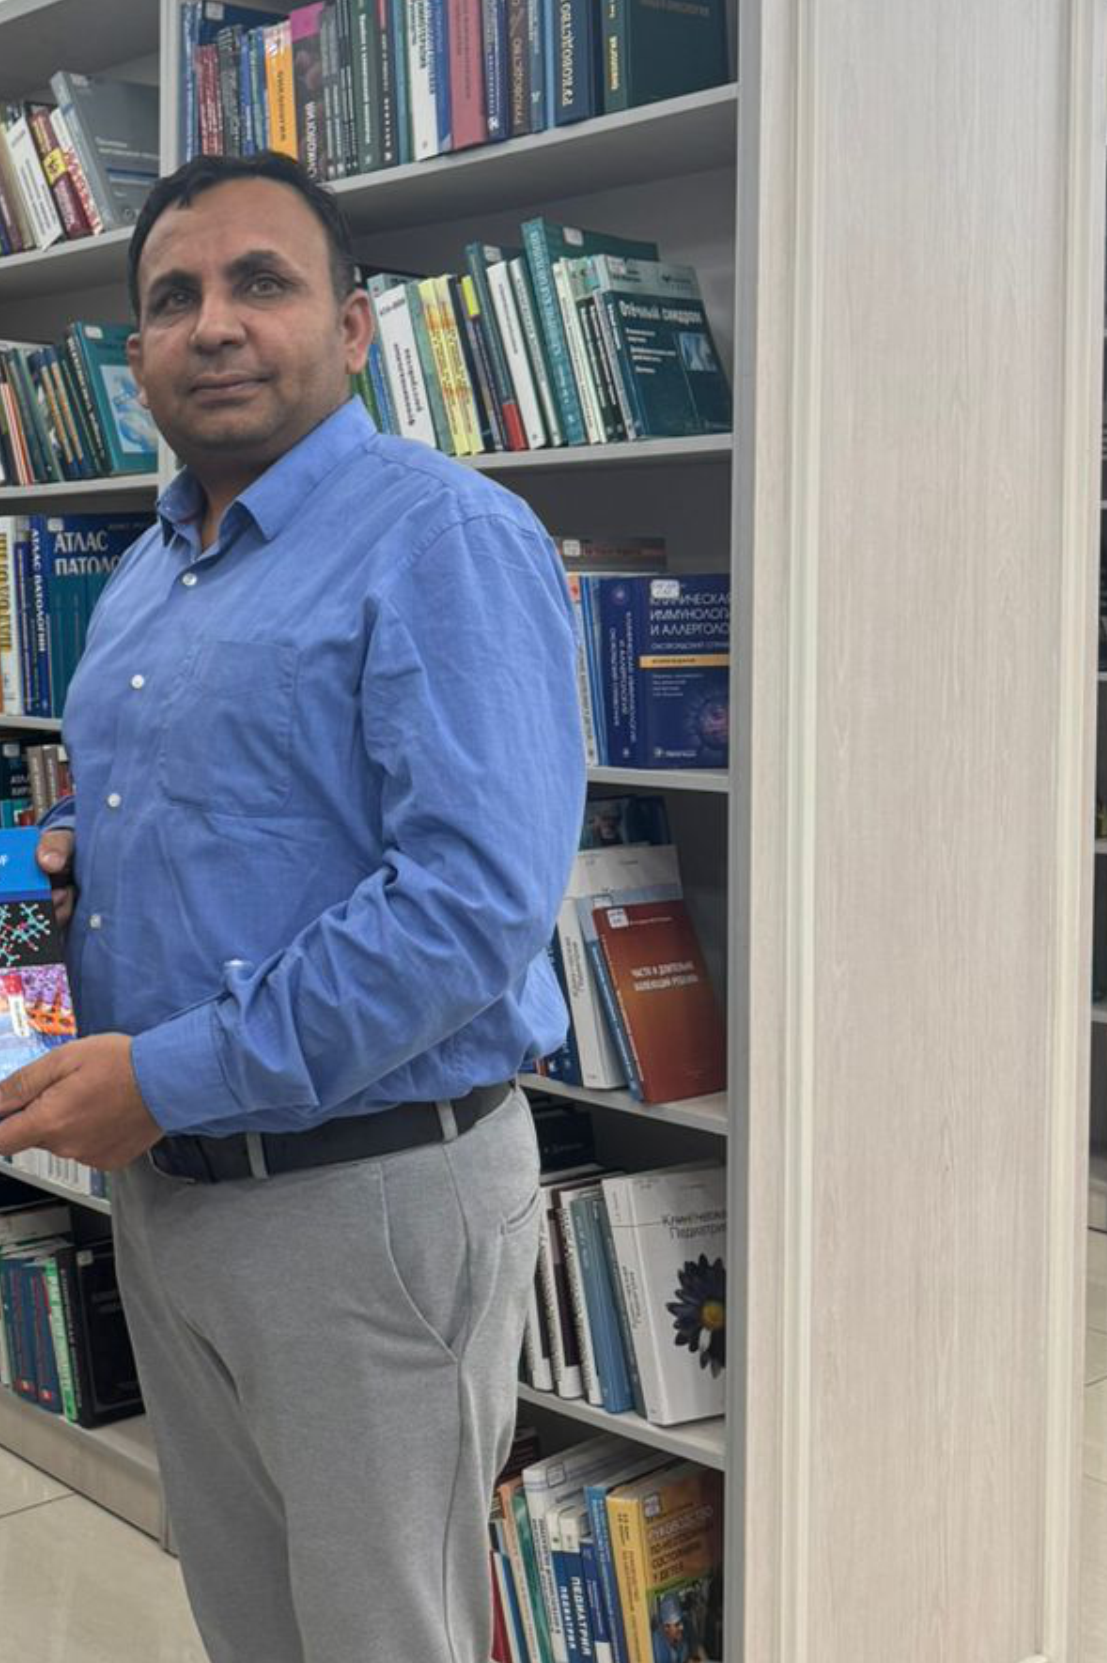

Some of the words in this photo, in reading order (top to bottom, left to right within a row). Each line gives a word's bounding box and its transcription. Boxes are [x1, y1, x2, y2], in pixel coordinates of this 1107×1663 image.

[31, 527, 42, 572] АТЛАС
[54, 530, 109, 553] АТЛАС
[571, 1576, 592, 1657] ПЕДИАТРИЯ
